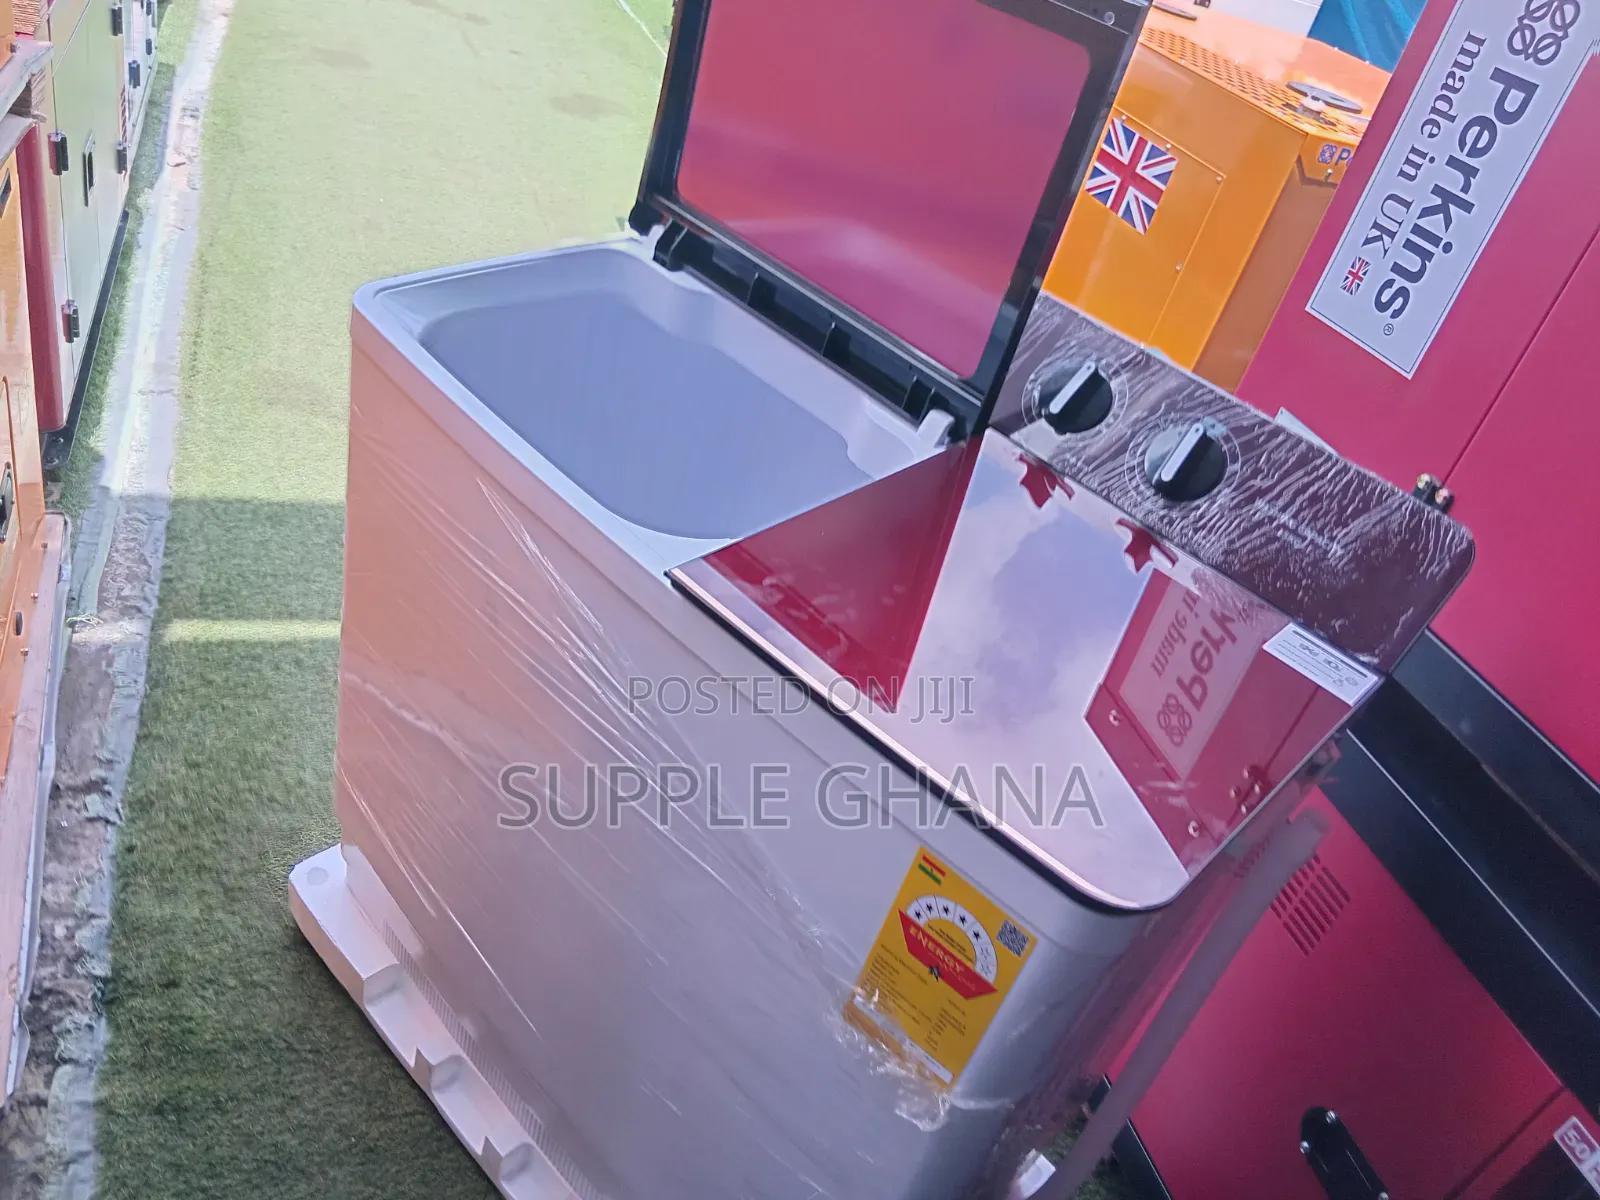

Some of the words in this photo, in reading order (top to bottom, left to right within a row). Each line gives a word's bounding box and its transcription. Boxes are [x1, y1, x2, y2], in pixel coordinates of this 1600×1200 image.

[1420, 30, 1487, 139] made
[1374, 66, 1540, 320] Perkins
[1397, 144, 1436, 182] in
[1361, 192, 1415, 259] UK
[909, 925, 965, 973] ENERGY
